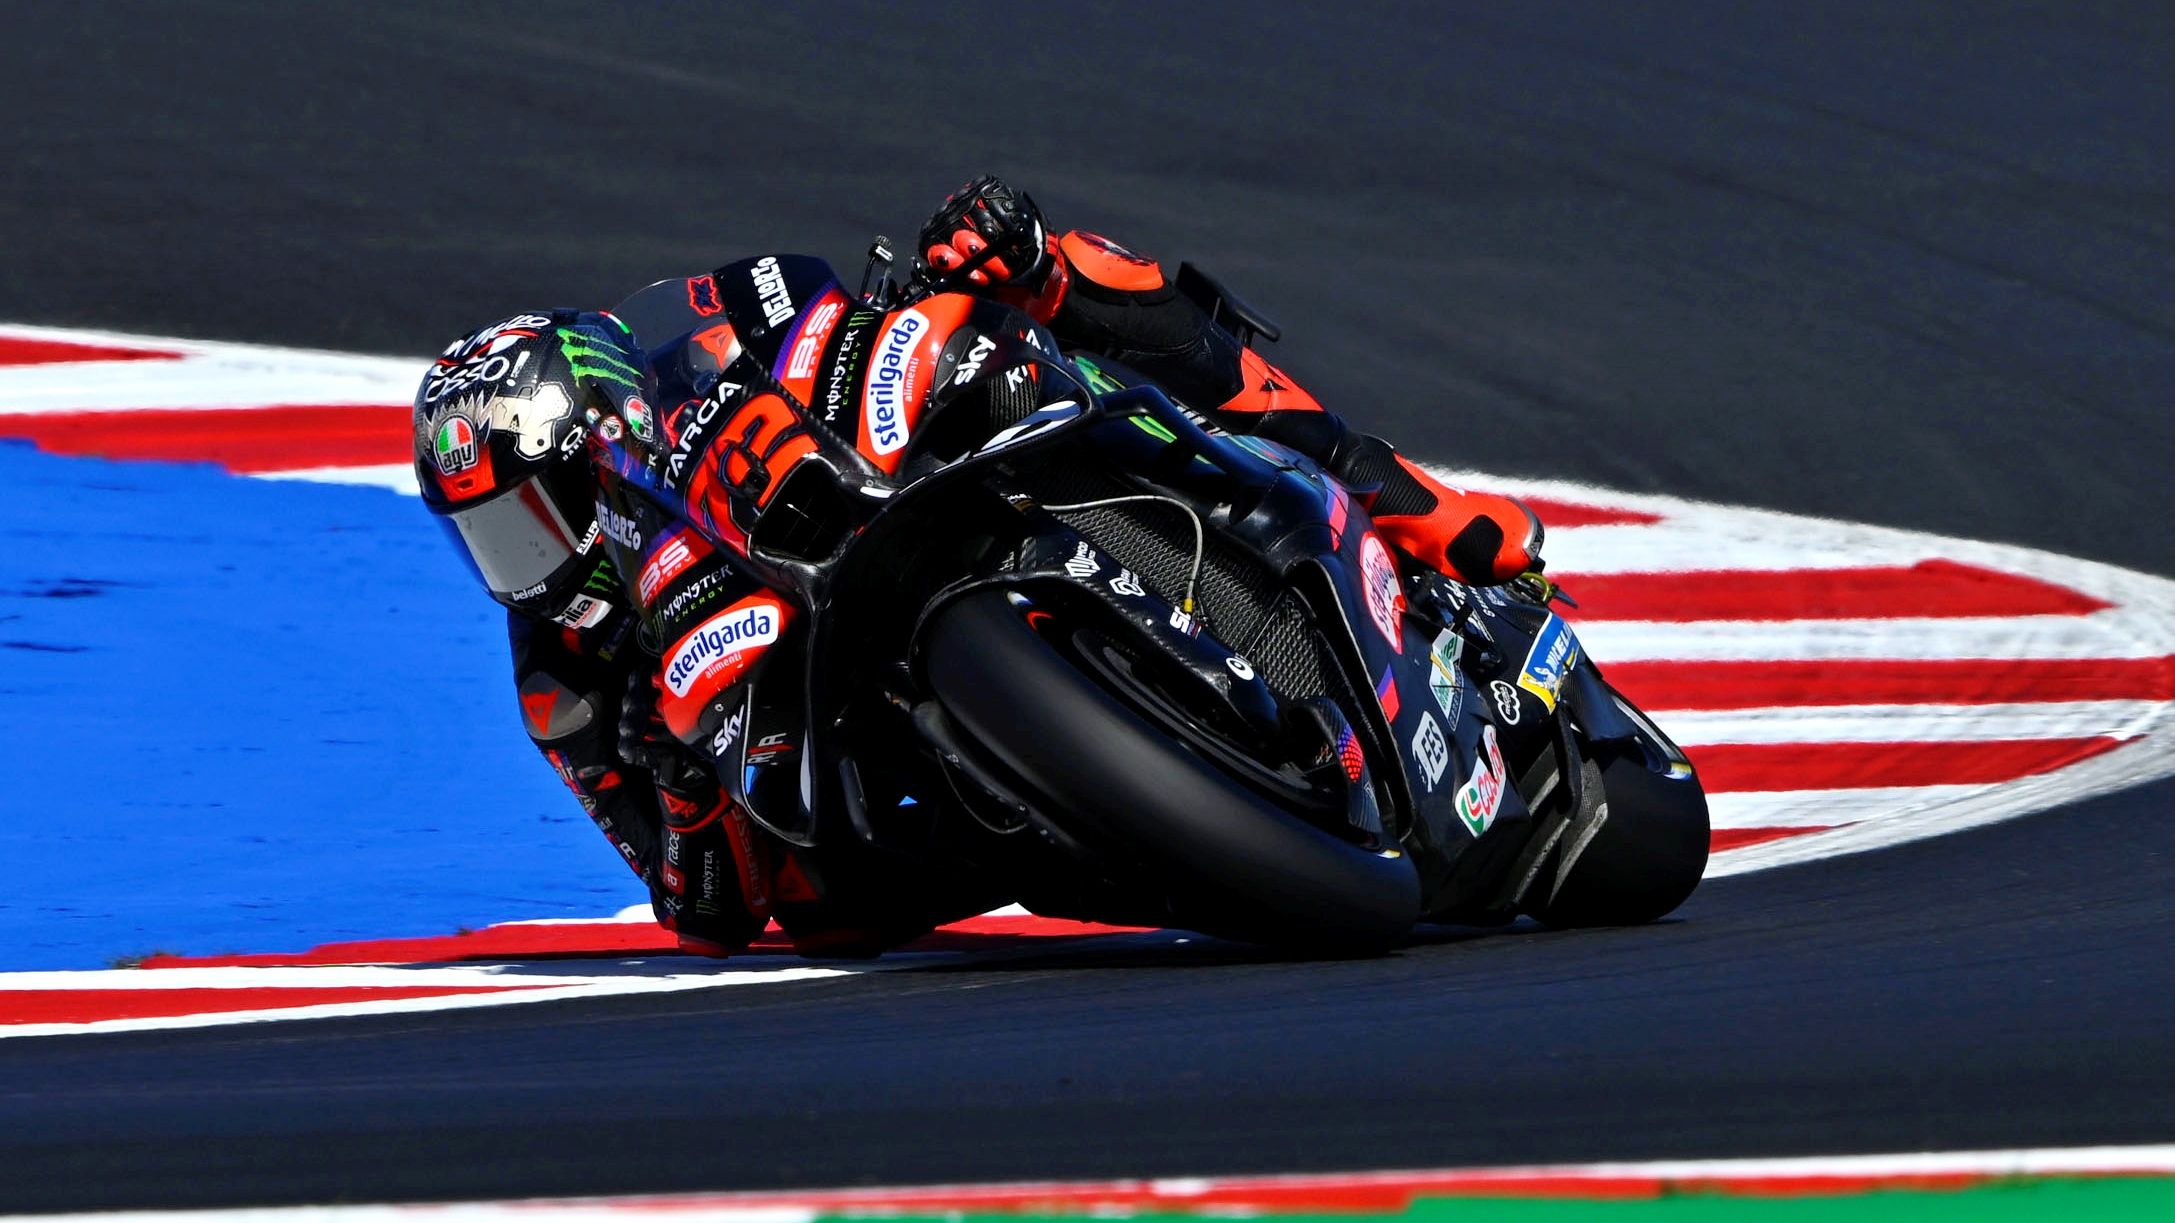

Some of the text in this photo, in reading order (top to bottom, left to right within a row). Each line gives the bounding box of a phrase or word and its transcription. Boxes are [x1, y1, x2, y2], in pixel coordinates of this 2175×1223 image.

[750, 256, 796, 329] DELLORTO
[786, 302, 838, 379] BS
[825, 328, 860, 422] MONSTER
[870, 317, 920, 446] sterilgarda
[903, 357, 920, 403] alimenti
[662, 381, 743, 490] TARGA
[512, 581, 548, 602] belotti
[640, 537, 691, 603] BS
[663, 563, 735, 621] MONSTER
[668, 609, 771, 689] sterilgarda
[705, 652, 743, 679] alimenti
